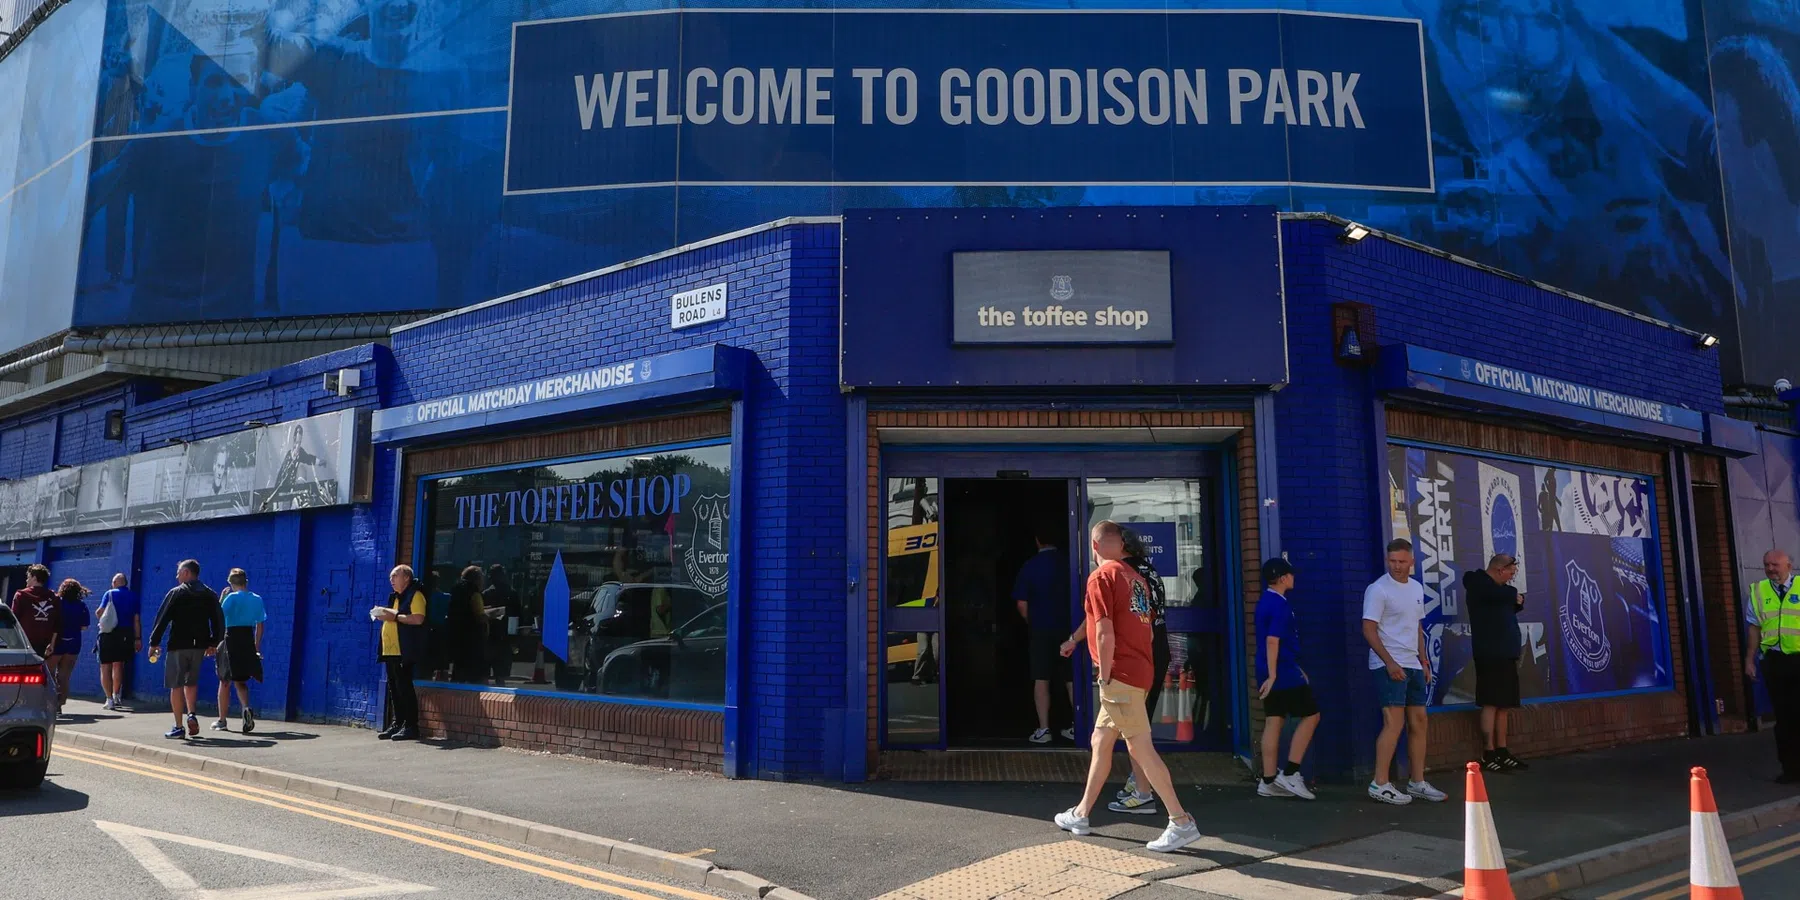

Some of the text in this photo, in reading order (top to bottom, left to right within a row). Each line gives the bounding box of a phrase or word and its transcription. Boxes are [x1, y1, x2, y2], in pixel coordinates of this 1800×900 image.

[574, 67, 1366, 130] WELCOME TO GOODISON PARK
[676, 288, 722, 310] BULLENS
[679, 307, 721, 324] ROAD L4
[977, 305, 1149, 331] the toffee shop
[417, 363, 634, 422] OFFICIAL MATCHDAY MERCHANDISE
[1475, 363, 1664, 422] OFFICIAL MATCHDAY MERCHANDISE
[454, 473, 691, 529] THE TOFFEE SHOP
[1138, 535, 1154, 543] ARD
[1573, 613, 1601, 645] Everton
